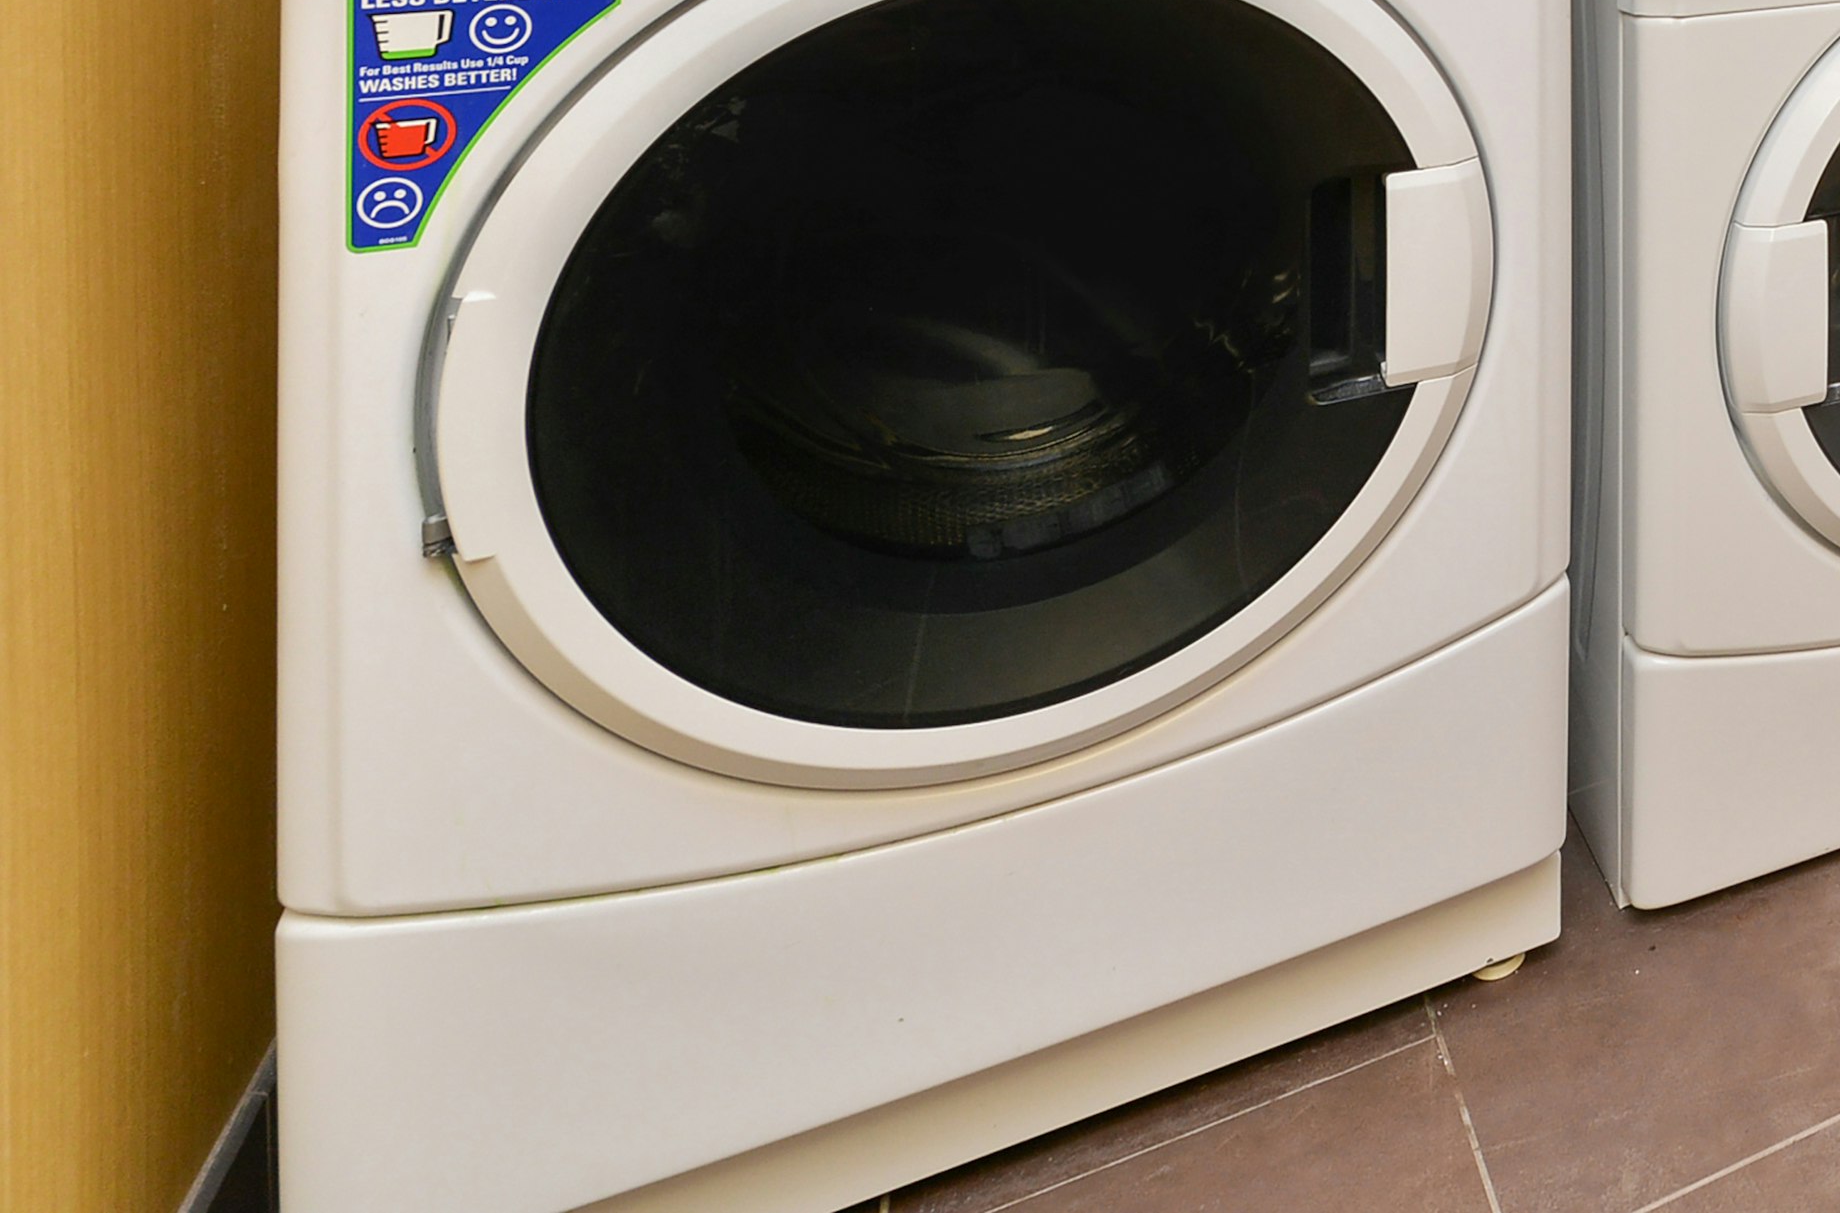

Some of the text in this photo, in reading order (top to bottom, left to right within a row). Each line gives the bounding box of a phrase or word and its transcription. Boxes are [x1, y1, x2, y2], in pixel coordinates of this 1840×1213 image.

[359, 55, 529, 78] For Best Results Use 1/4 Cup
[359, 68, 517, 94] WASHES BETTER!
